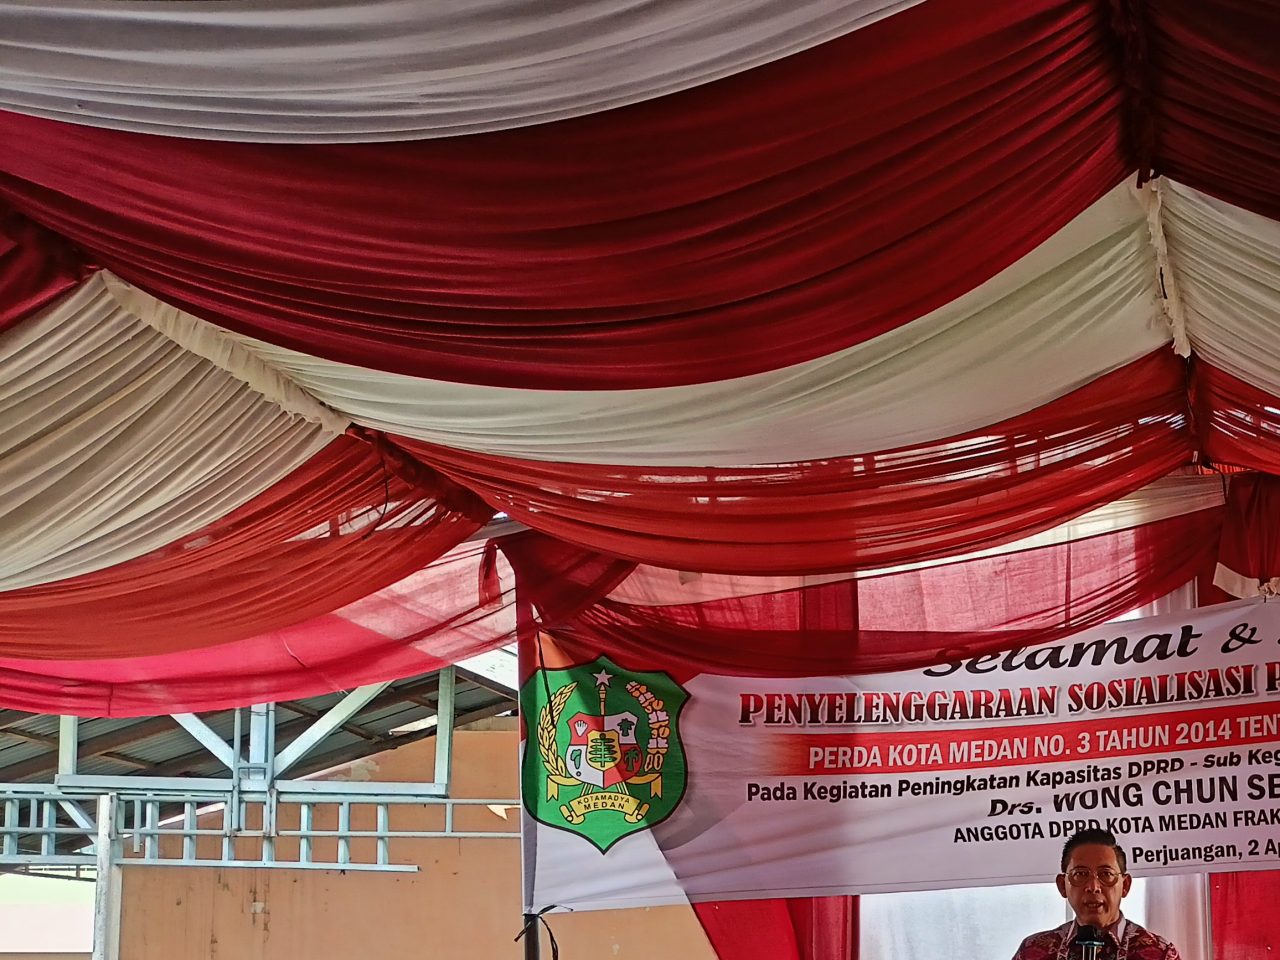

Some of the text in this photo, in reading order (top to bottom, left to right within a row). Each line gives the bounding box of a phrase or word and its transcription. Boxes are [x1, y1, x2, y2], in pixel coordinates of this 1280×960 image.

[1220, 622, 1263, 653] &
[738, 683, 1059, 727] PENYELENGGARAAN
[1067, 663, 1257, 714] SOSIALISASI
[808, 744, 883, 770] PERDA
[888, 742, 944, 767] KOTA
[948, 736, 1029, 763] MEDAN
[1033, 734, 1072, 758] NO.
[1076, 735, 1090, 753] 3
[1095, 724, 1170, 752] TAHUN
[1175, 719, 1232, 745] 2014
[746, 782, 797, 802] Pada
[802, 780, 892, 804] Kegiatan
[897, 774, 1020, 800] Peningkatan
[1025, 762, 1122, 789] Kapasitas
[1127, 757, 1185, 779] DPRD
[1202, 751, 1242, 769] Sub
[577, 795, 630, 805] KOTAMADYA
[583, 802, 624, 810] MEDAN
[987, 798, 1043, 818] Drs.
[1052, 782, 1144, 813] WONG
[1152, 774, 1239, 806] CHUN
[953, 824, 1045, 844] ANGGOTA
[1105, 815, 1155, 835] KOTA
[1158, 810, 1228, 832] MEDAN
[1132, 841, 1243, 866] Perjuangan,
[1247, 838, 1260, 856] 2
